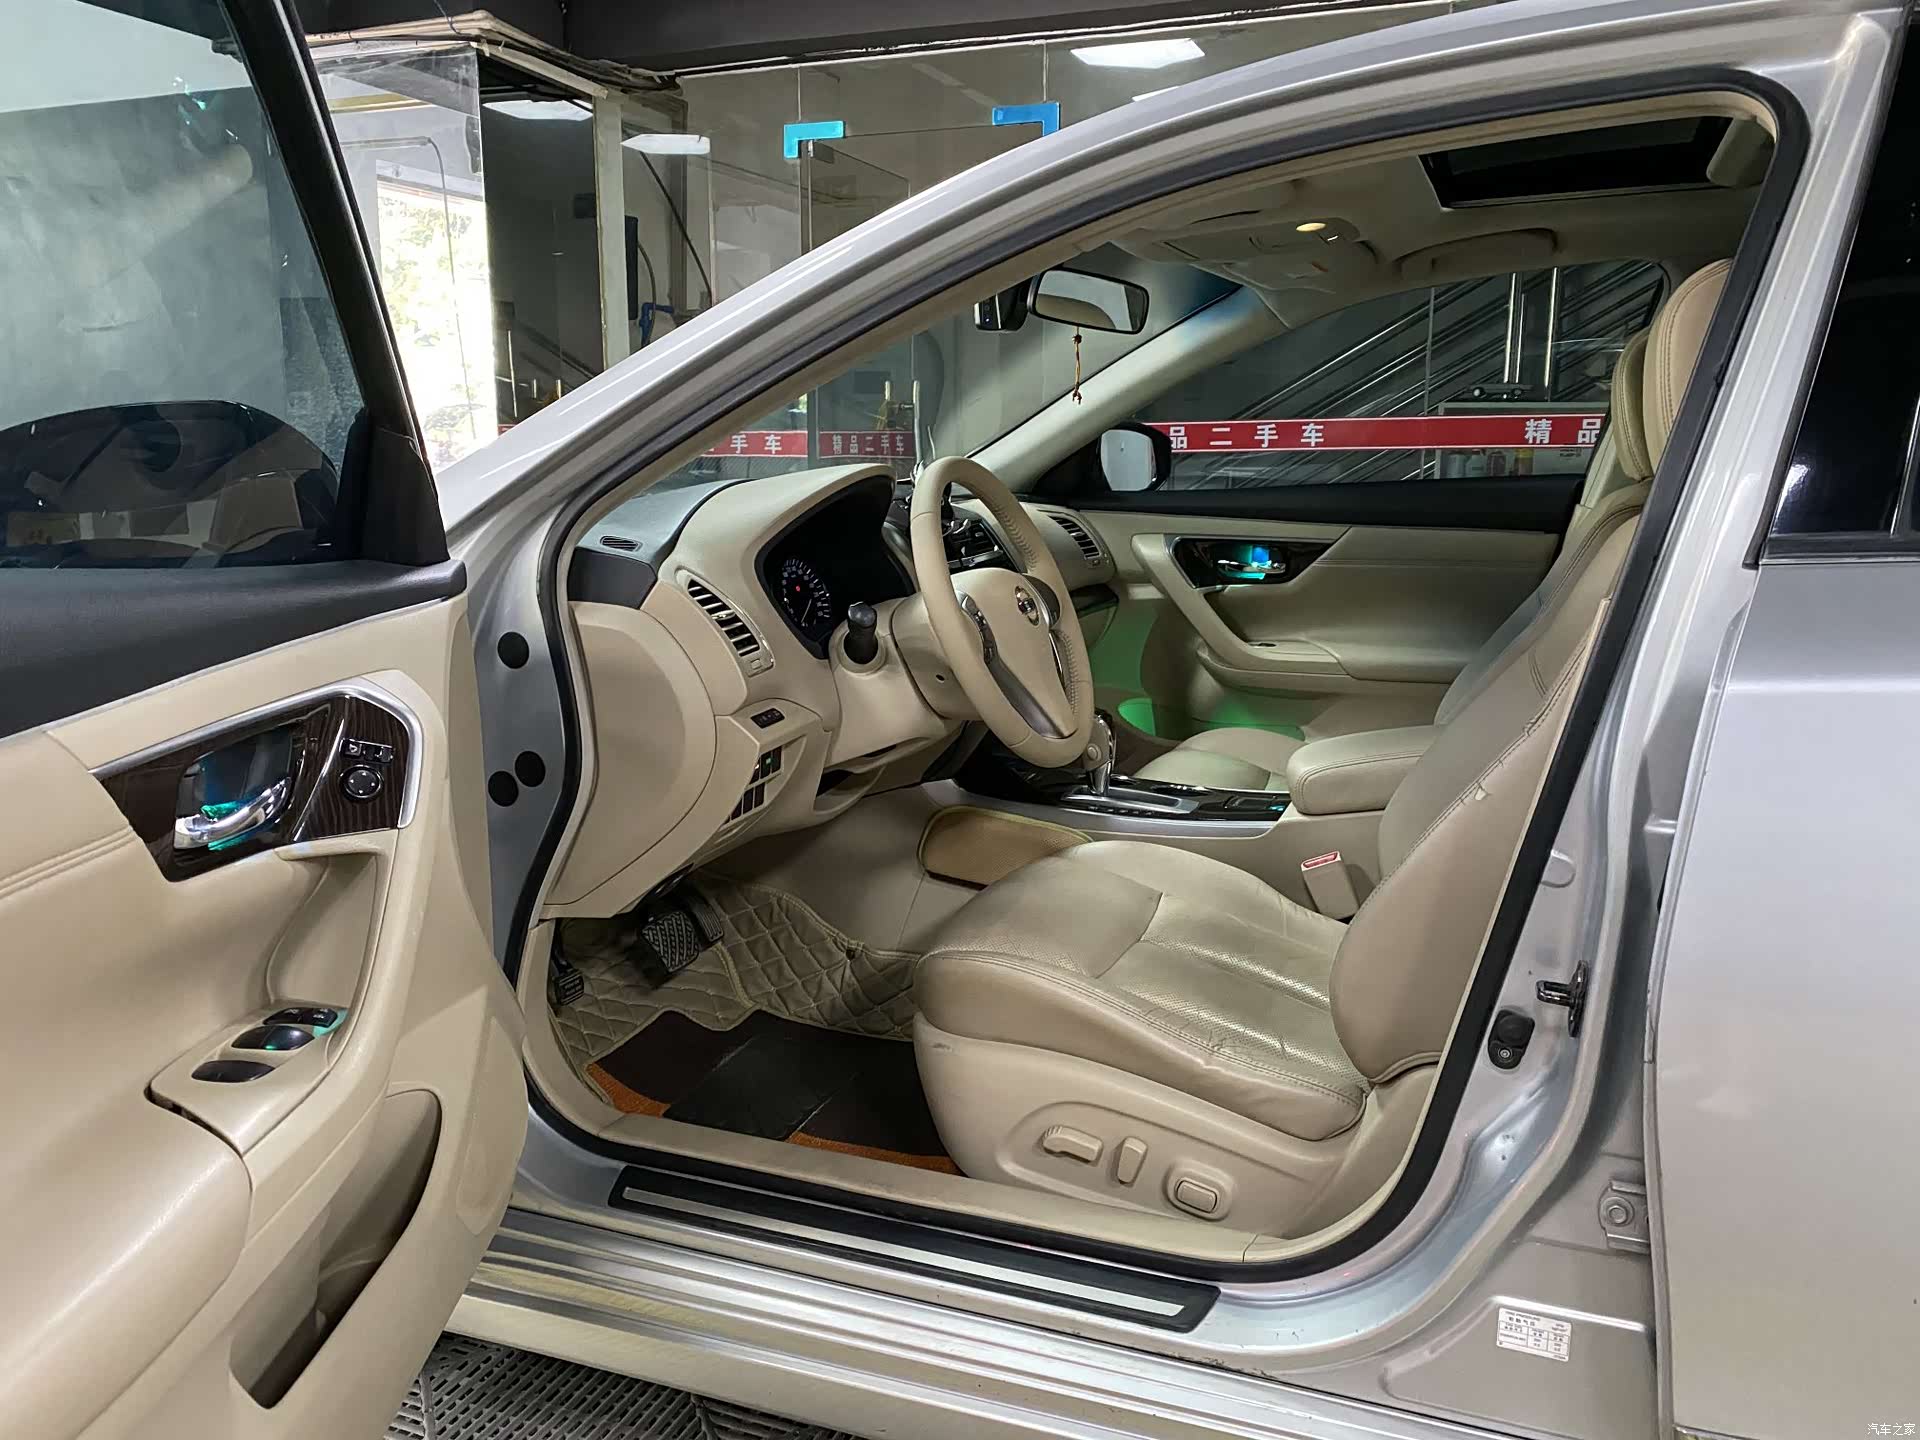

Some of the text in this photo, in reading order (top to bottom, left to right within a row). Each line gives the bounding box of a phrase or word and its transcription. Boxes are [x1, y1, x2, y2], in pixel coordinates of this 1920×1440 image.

[1169, 423, 1325, 450] 品二手车
[1525, 419, 1601, 444] 精品
[708, 434, 783, 455] 手车
[832, 434, 904, 456] 精品二手车
